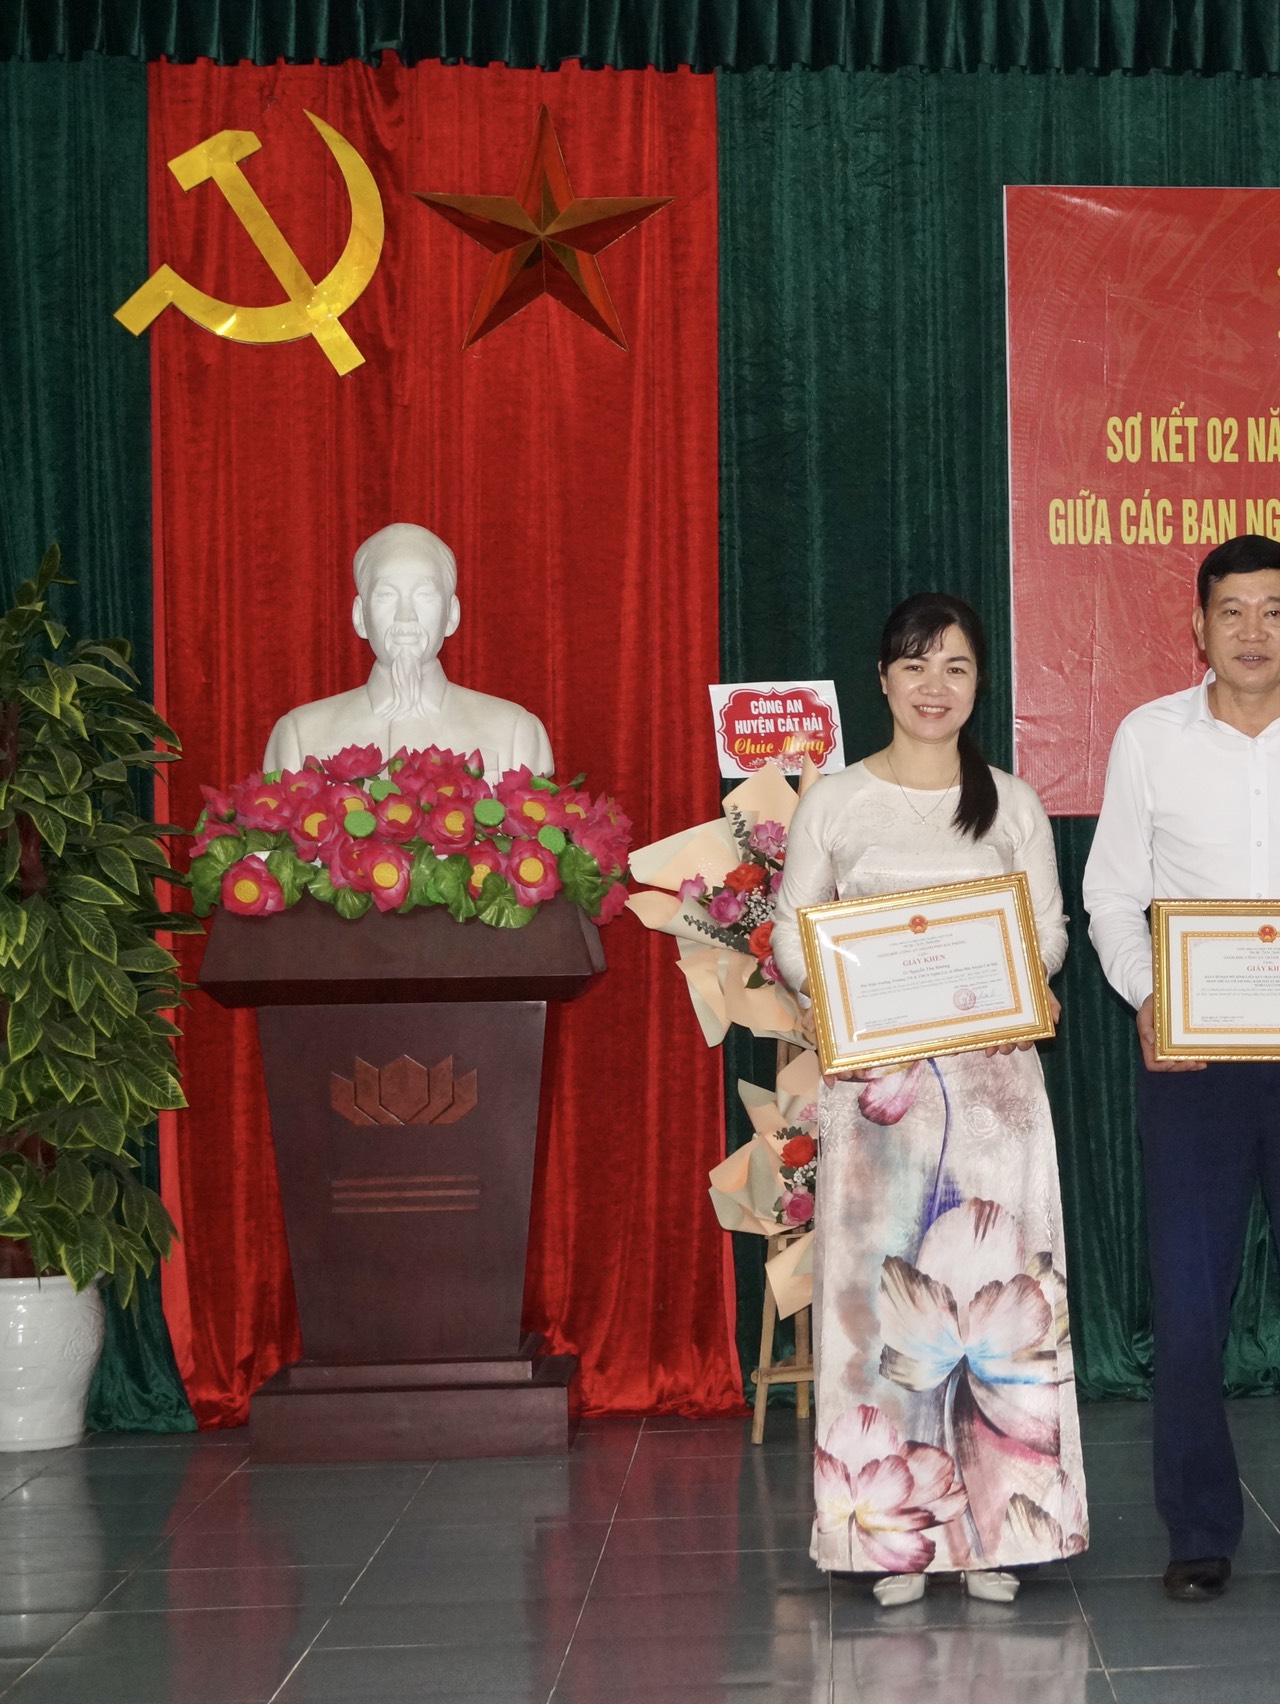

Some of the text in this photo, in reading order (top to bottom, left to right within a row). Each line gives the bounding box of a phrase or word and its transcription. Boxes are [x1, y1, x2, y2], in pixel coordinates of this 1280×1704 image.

[1106, 411, 1142, 463] SƠ
[1150, 402, 1199, 463] KẾT
[1207, 417, 1239, 463] 02
[1048, 488, 1113, 546] GIỮA
[1120, 488, 1173, 546] CÁC
[1182, 498, 1237, 545] BAN
[750, 697, 804, 715] CÔNG AN
[735, 713, 824, 736] HUYỆN CÁT HẢI
[734, 738, 774, 755] Chúc
